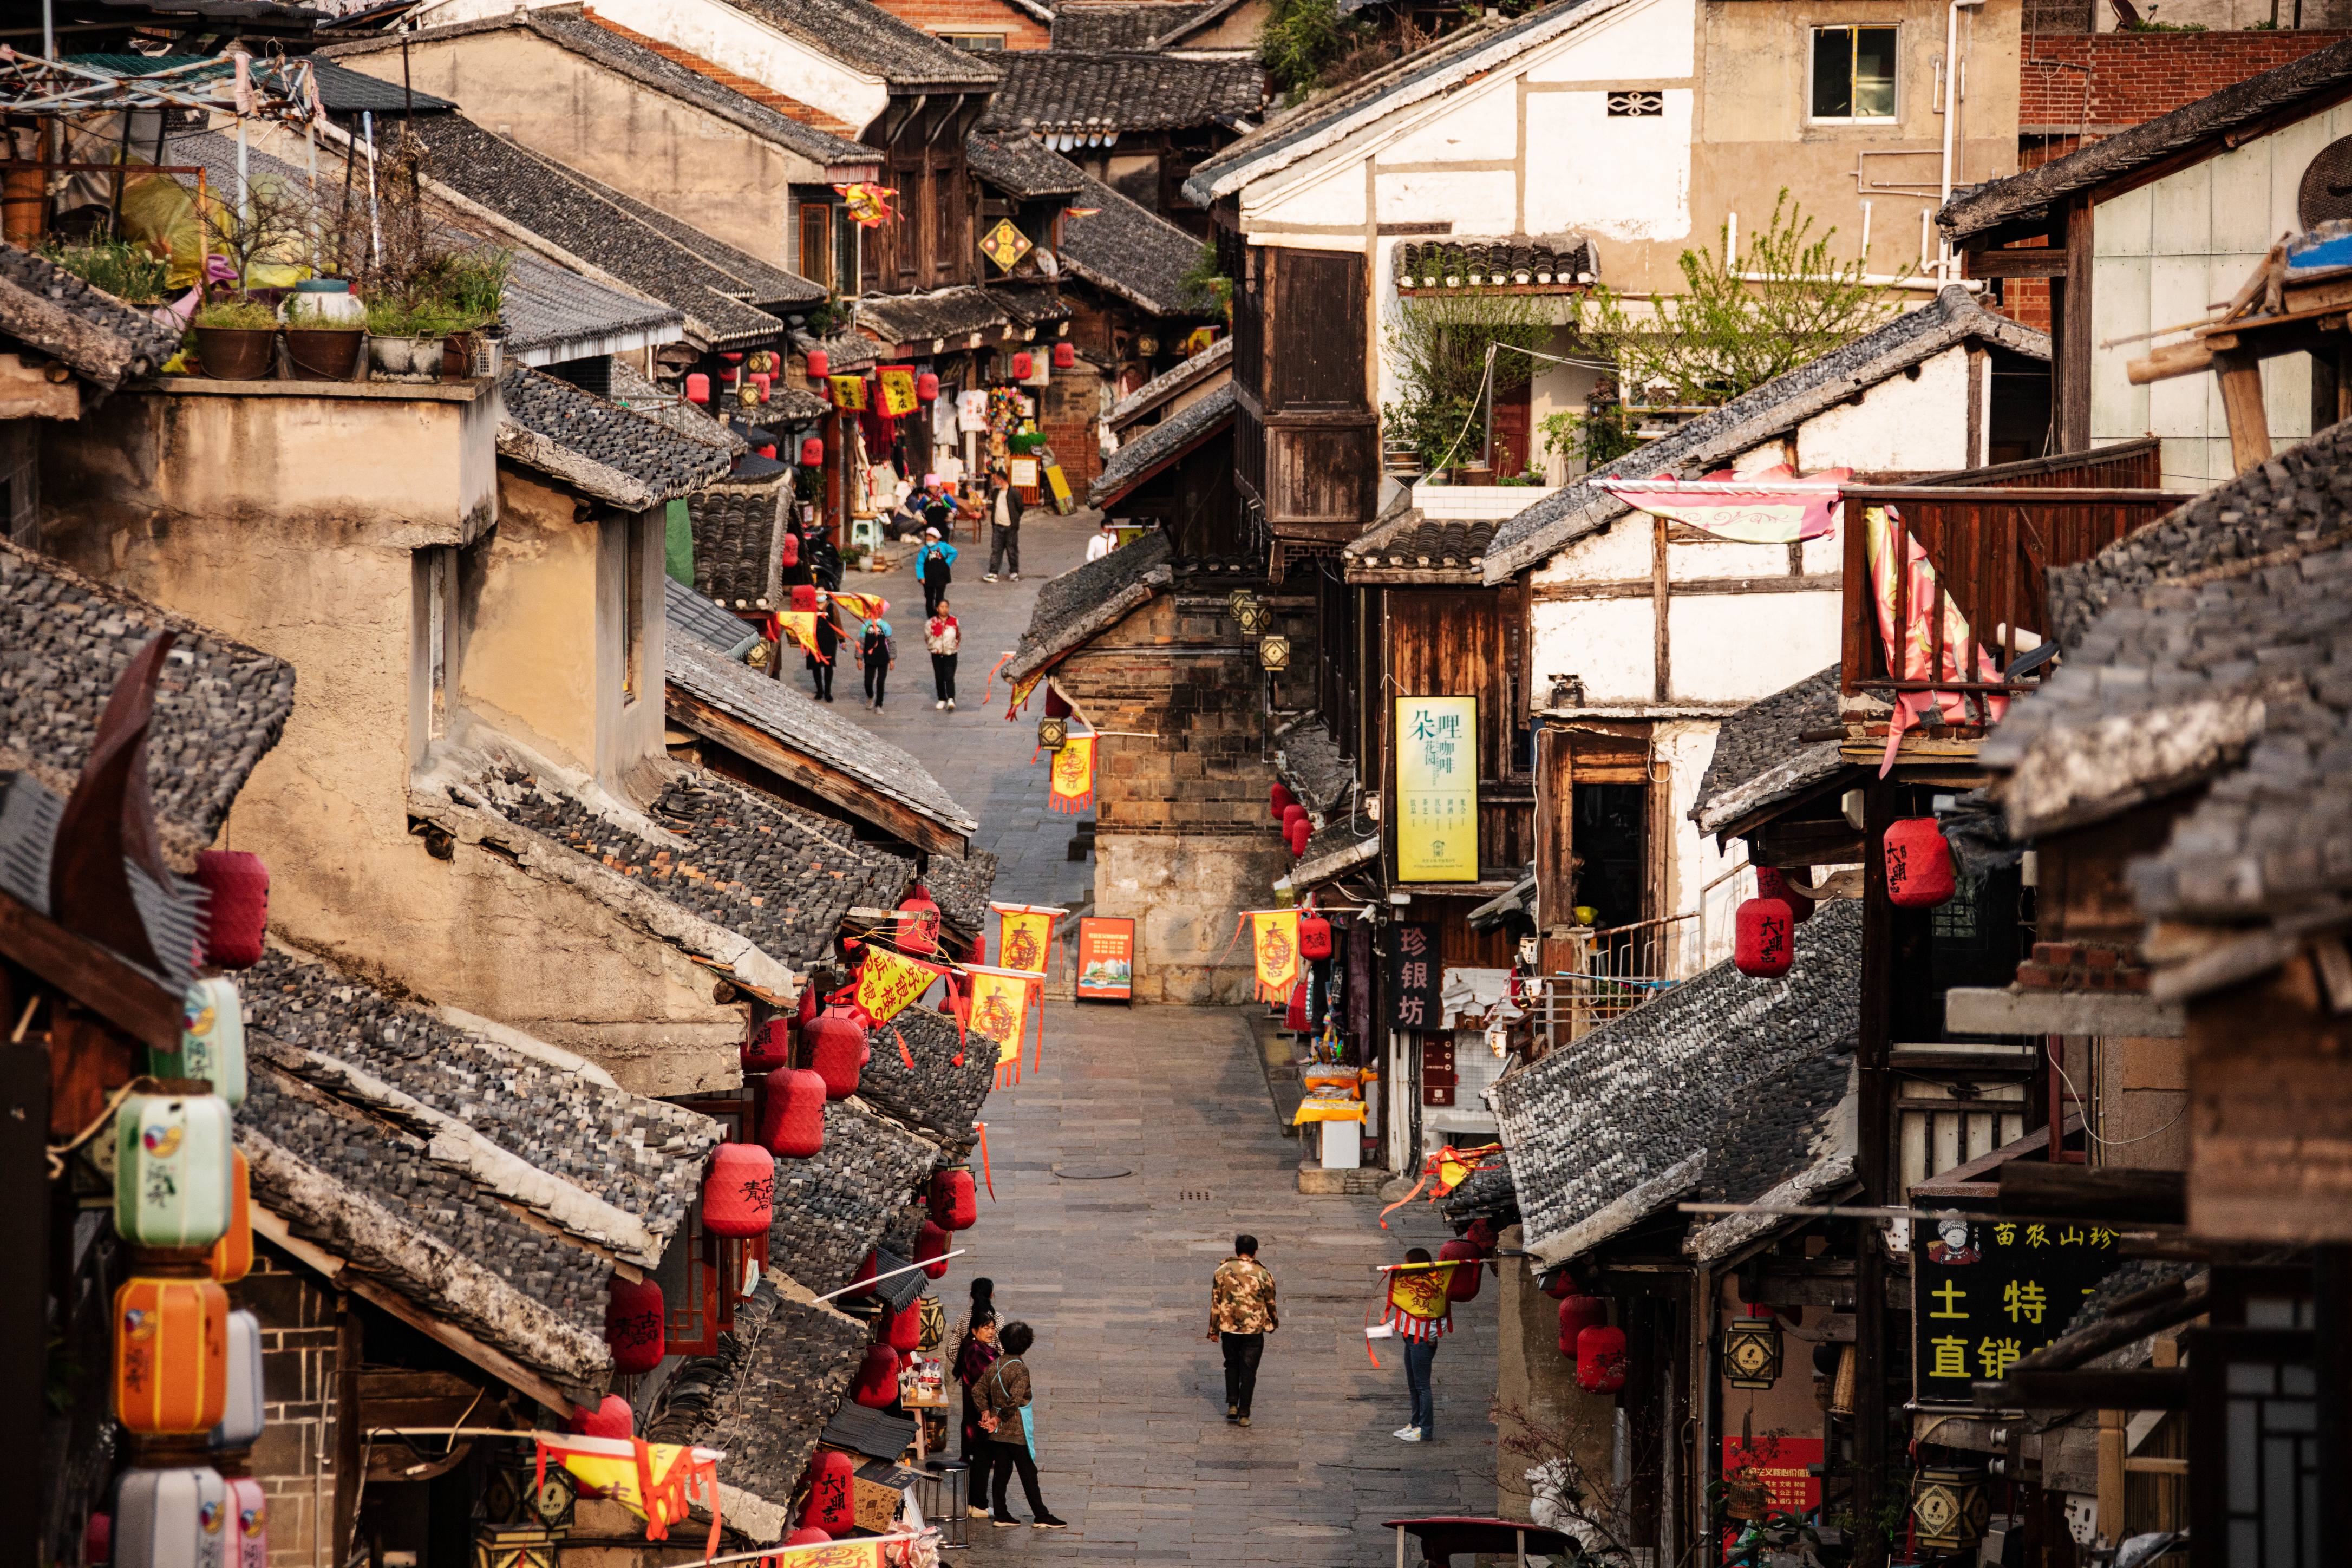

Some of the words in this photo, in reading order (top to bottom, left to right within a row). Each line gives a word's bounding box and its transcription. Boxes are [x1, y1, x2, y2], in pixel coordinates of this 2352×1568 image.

[1760, 916, 1783, 962] 大明志
[1398, 927, 1428, 1025] 珍银坊
[1993, 1221, 2120, 1250] 苗农山珍
[1929, 1334, 2055, 1380] 直销
[1741, 1468, 1811, 1478] 会主义核心价值
[821, 1474, 846, 1524] 大明志
